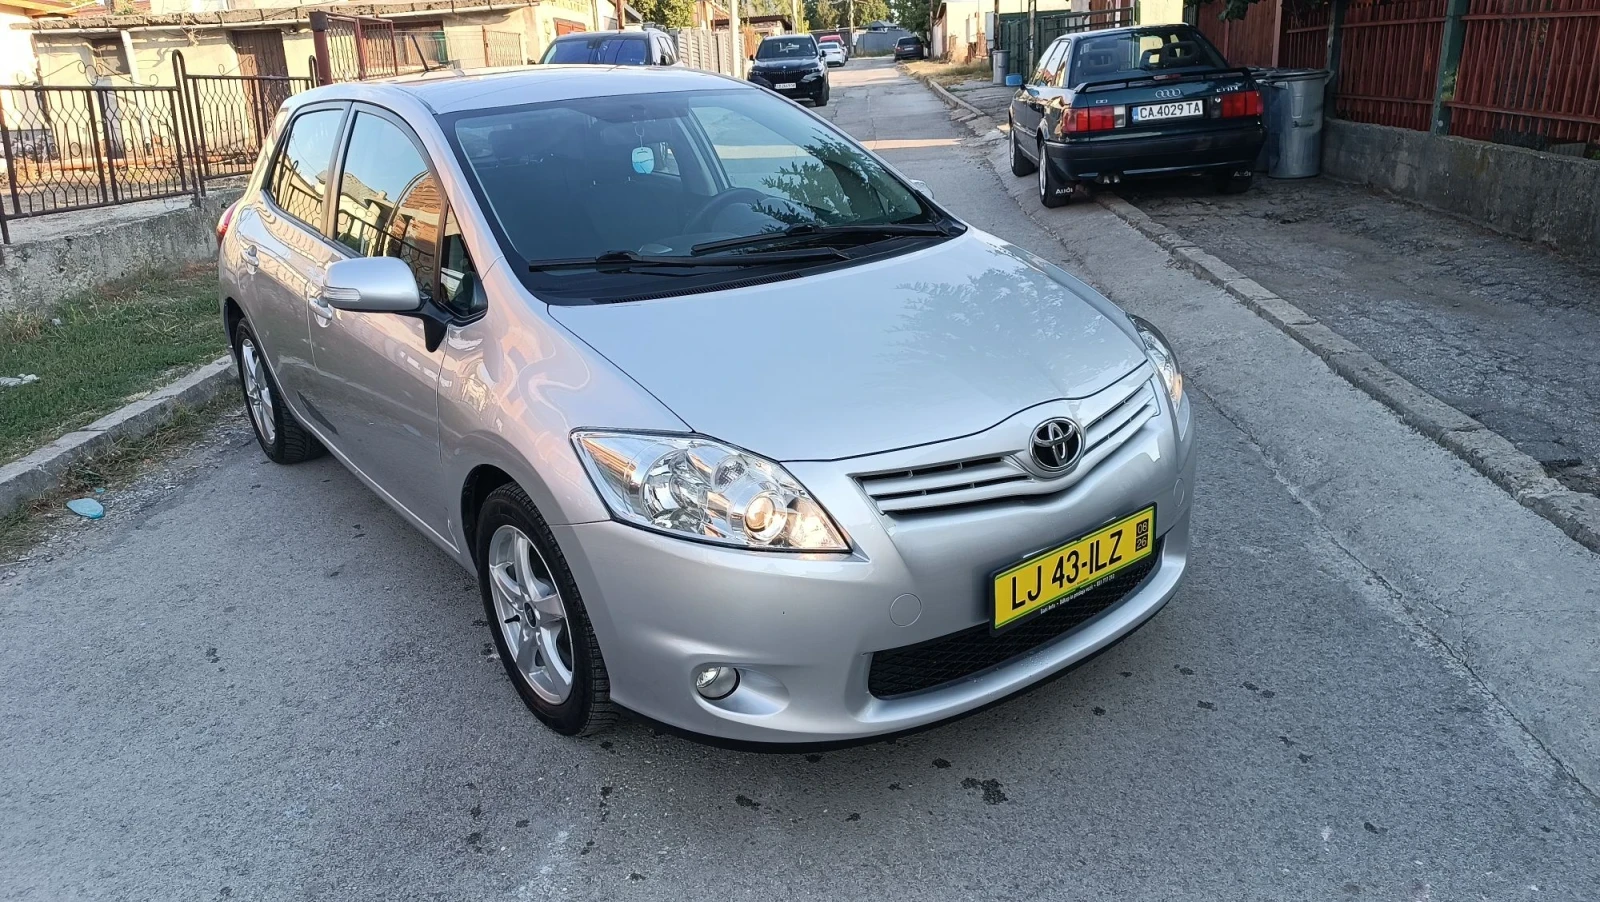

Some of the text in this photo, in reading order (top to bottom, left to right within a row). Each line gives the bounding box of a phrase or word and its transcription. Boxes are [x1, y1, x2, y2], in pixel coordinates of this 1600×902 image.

[1139, 107, 1155, 119] CA
[1156, 103, 1184, 117] 4029
[1185, 102, 1201, 114] TA
[1055, 186, 1073, 195] Audi
[1137, 521, 1148, 535] 08
[1136, 536, 1147, 550] 26
[1011, 565, 1042, 611] LJ
[1052, 528, 1123, 589] 43-ILZ
